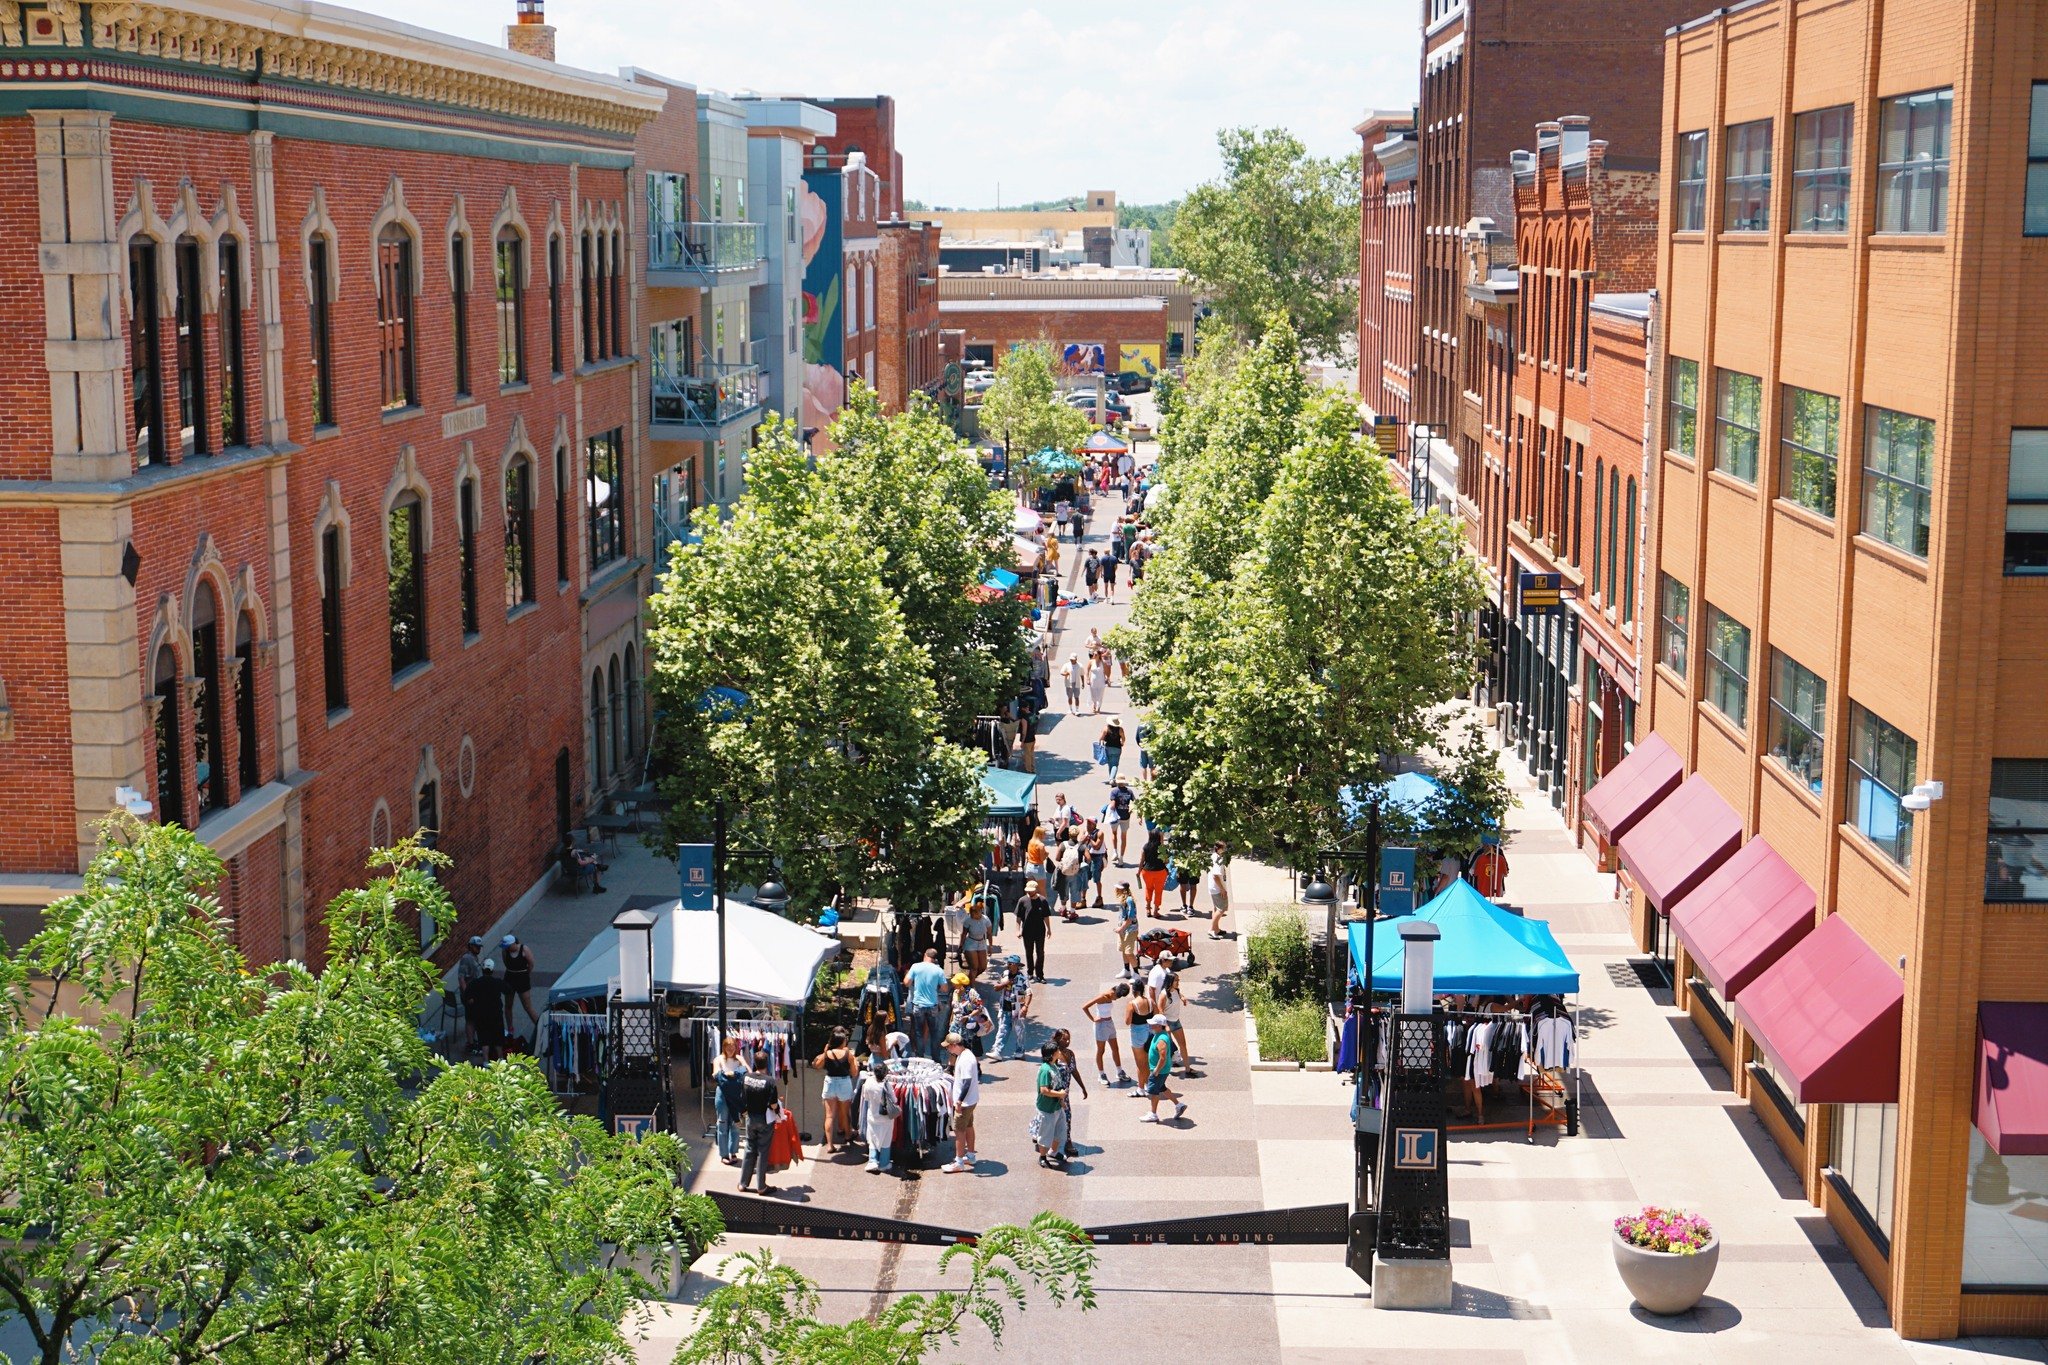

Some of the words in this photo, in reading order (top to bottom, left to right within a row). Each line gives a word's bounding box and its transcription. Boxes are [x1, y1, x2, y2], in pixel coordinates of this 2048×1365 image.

[778, 1225, 811, 1236] THE
[838, 1229, 918, 1241] LANDING
[1132, 1233, 1166, 1242] THE
[1193, 1233, 1275, 1242] LANDING
